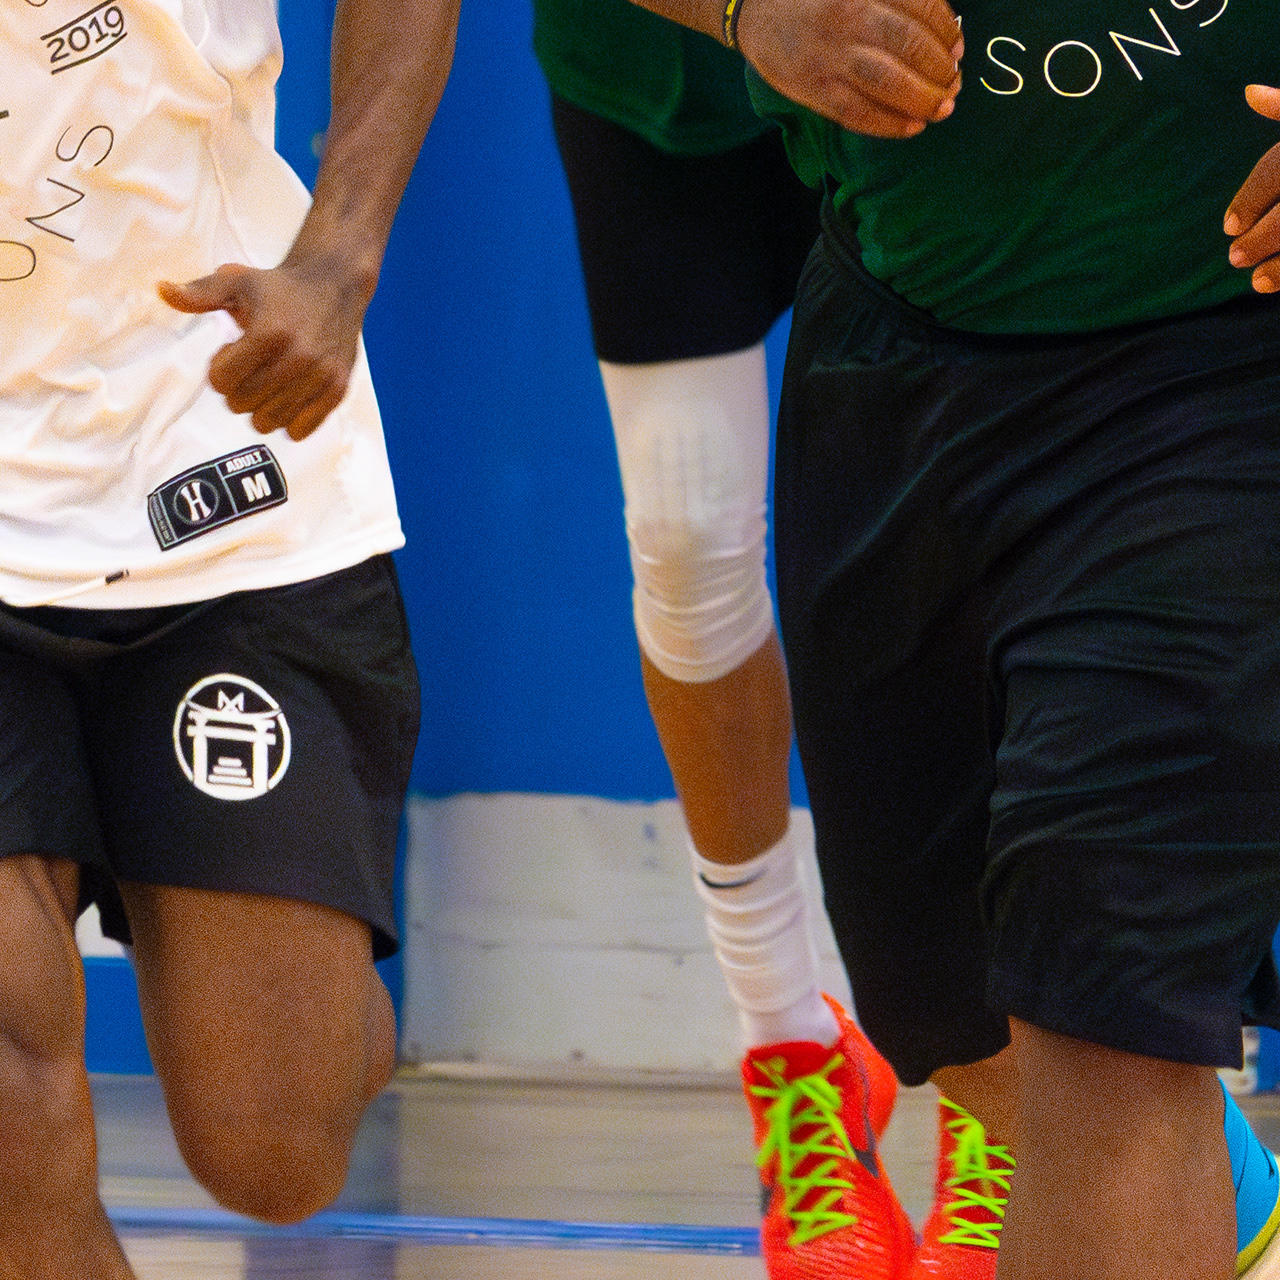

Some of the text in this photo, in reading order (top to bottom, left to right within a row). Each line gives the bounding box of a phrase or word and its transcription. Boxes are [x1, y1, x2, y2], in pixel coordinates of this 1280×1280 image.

[47, 4, 125, 65] 2019
[225, 451, 263, 474] ADULT
[241, 471, 272, 503] M
